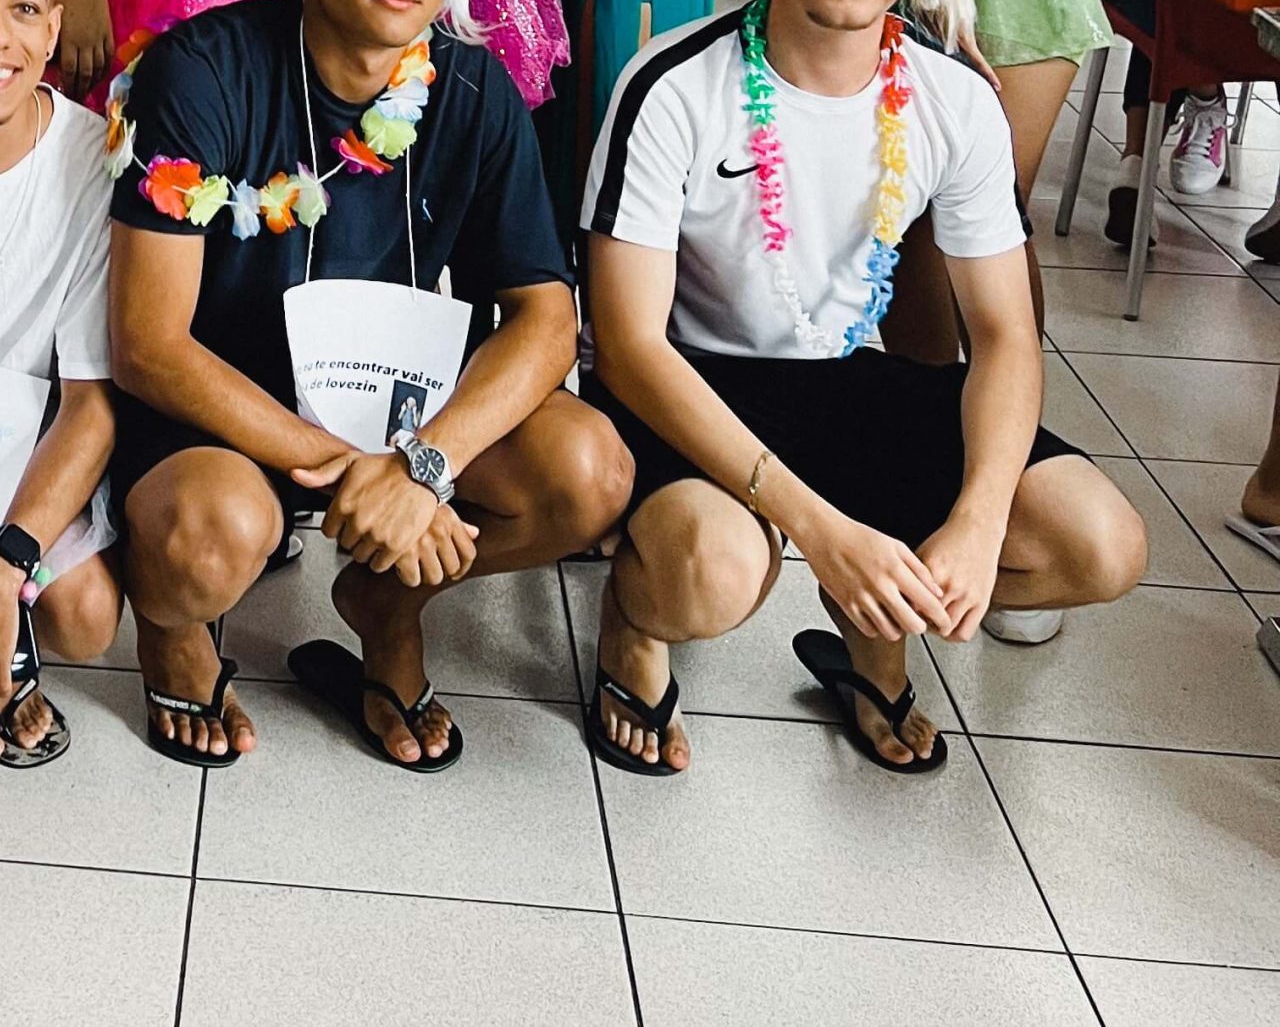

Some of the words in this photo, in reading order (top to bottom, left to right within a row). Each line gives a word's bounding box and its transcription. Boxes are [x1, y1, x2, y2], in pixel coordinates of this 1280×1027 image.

[325, 376, 378, 393] lovezin
[329, 360, 399, 377] encontrar
[401, 369, 424, 384] vai
[425, 375, 444, 392] ser
